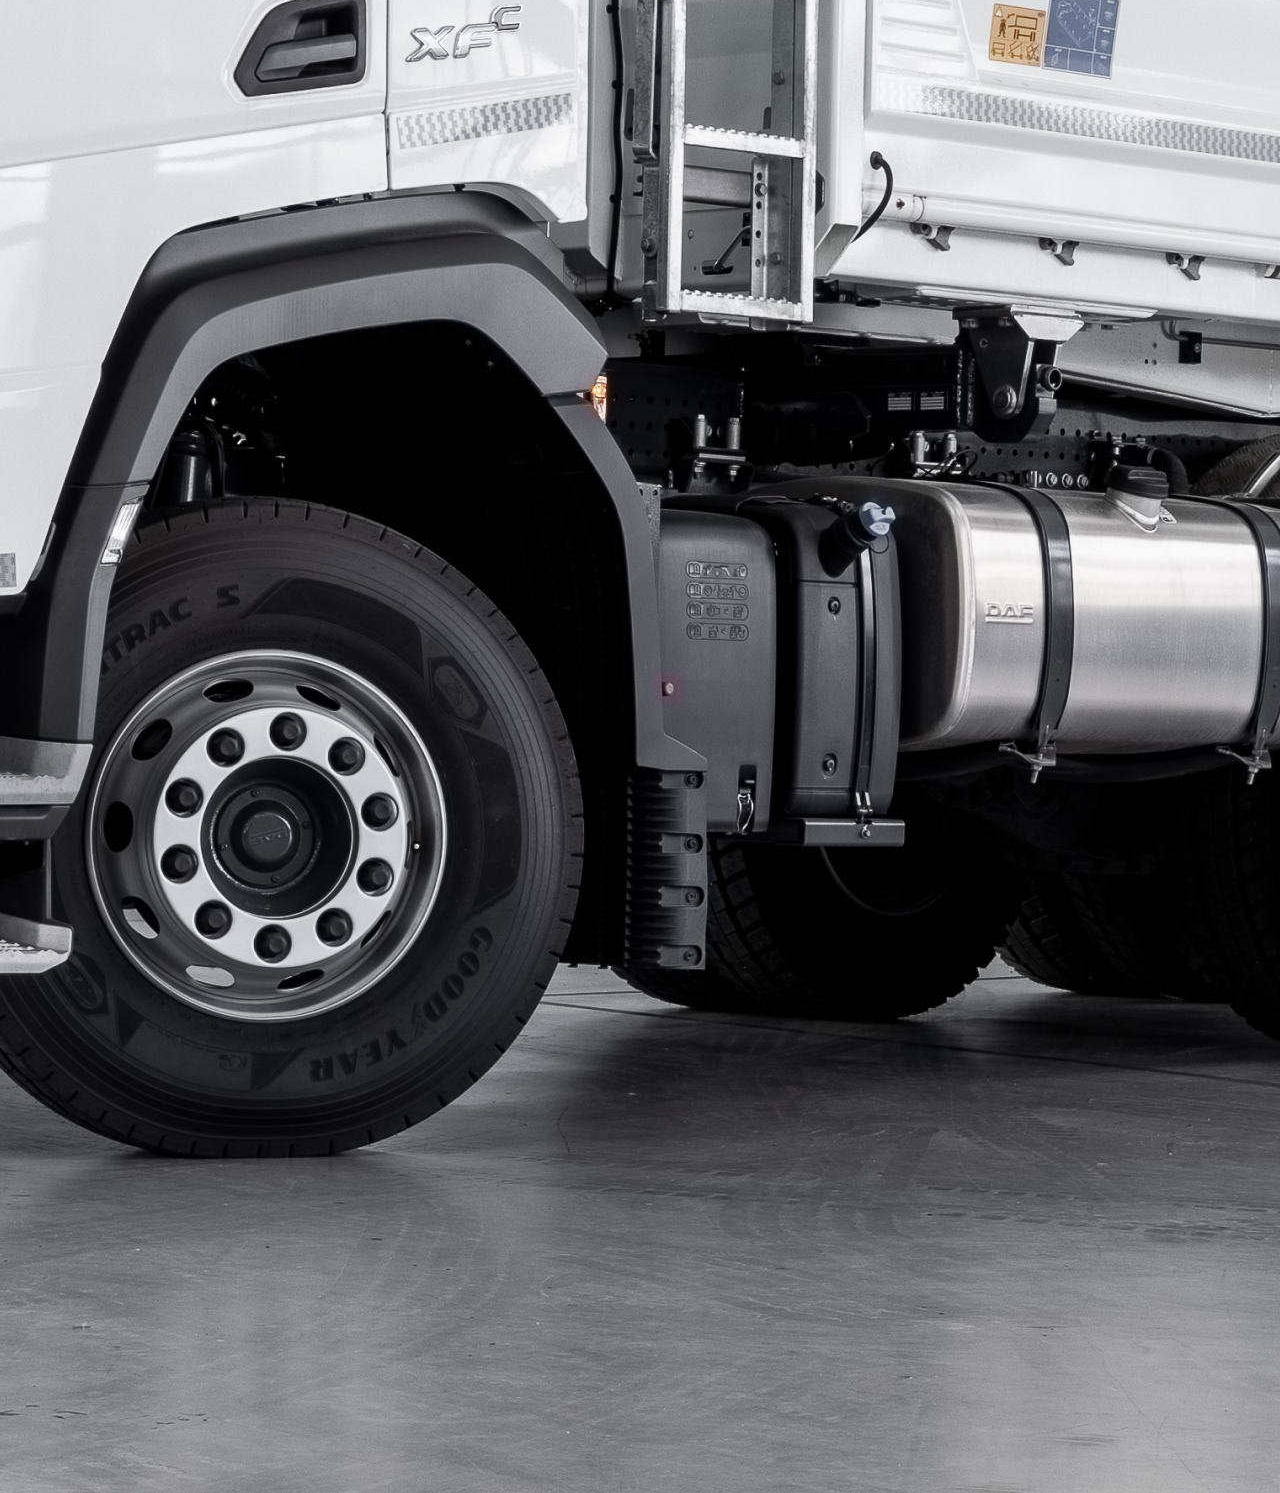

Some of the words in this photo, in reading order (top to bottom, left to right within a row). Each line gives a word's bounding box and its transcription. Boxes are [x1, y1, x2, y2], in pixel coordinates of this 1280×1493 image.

[100, 595, 193, 676] ITRAC
[216, 583, 241, 609] S
[984, 602, 1034, 619] DAF
